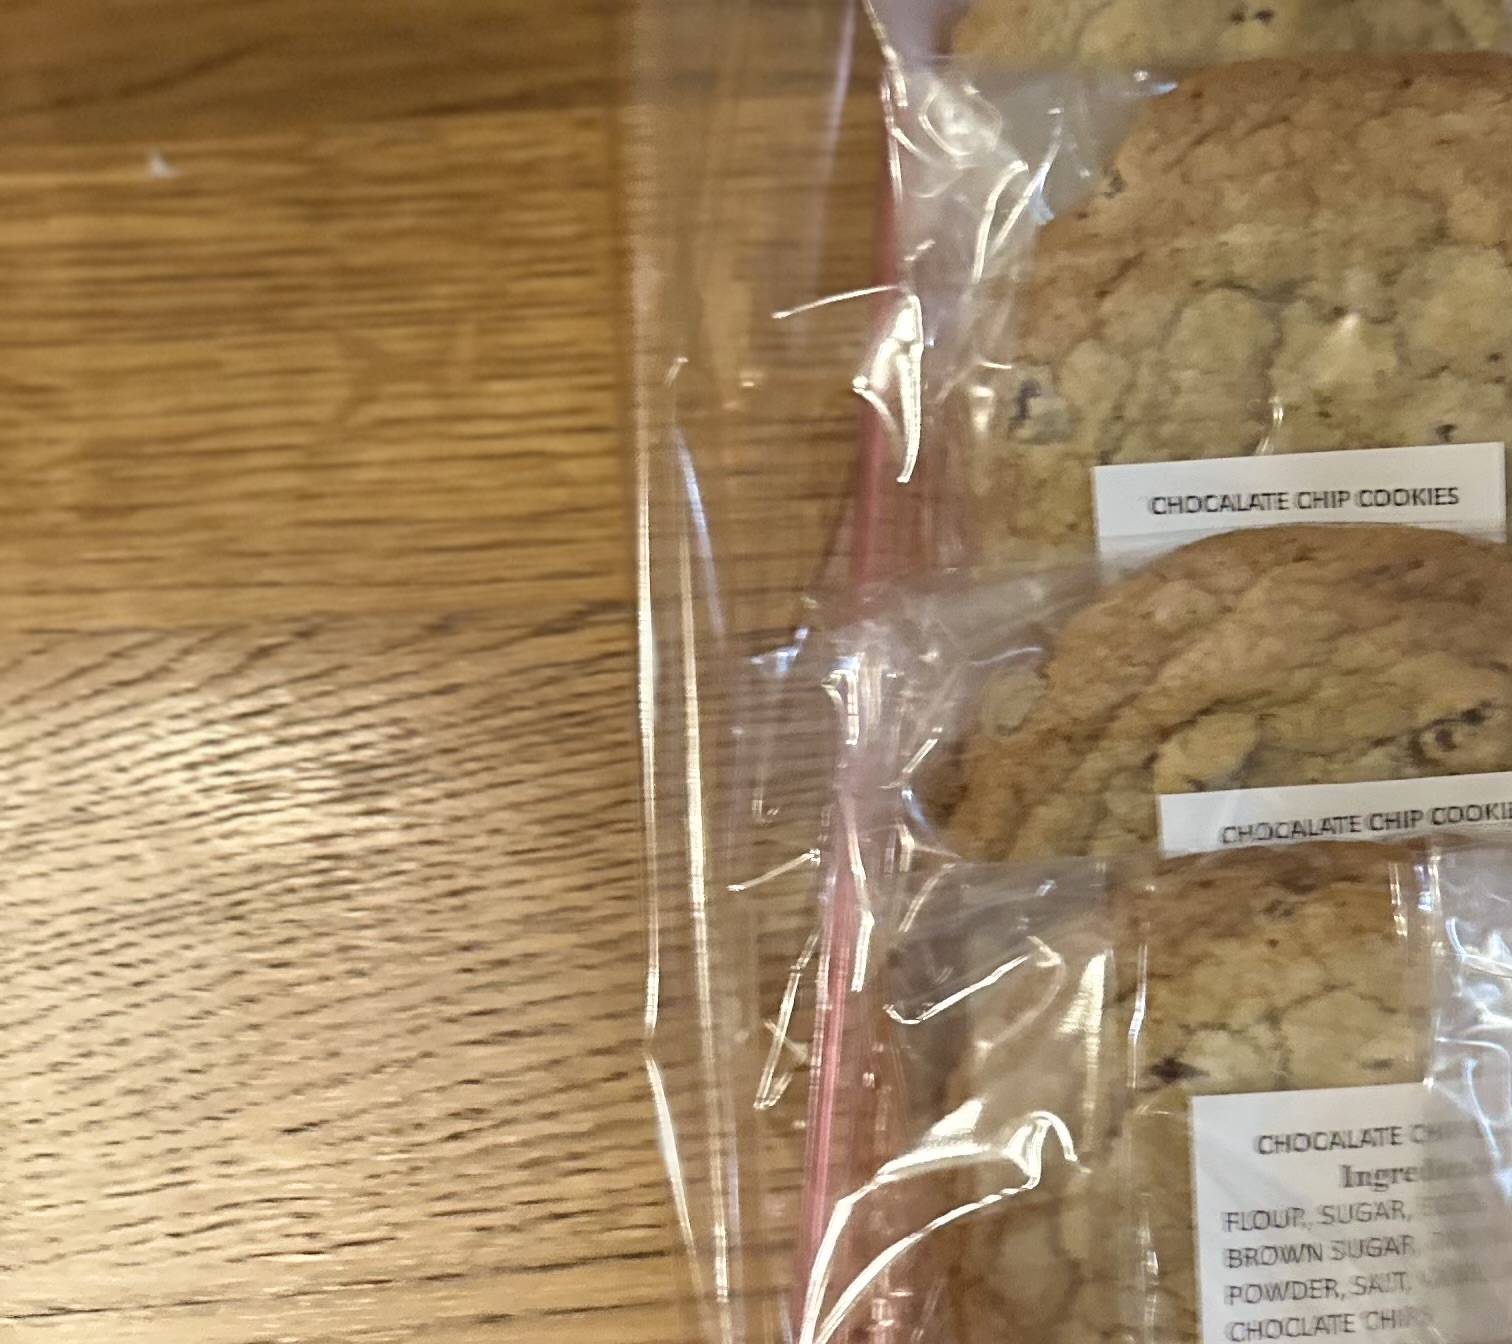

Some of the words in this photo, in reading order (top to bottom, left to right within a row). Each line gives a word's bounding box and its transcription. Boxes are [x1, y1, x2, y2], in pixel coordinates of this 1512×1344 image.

[1149, 492, 1289, 516] CHOCALATE
[1297, 490, 1350, 510] CHIP
[1356, 486, 1459, 508] COOKIES
[1220, 815, 1361, 844] CHOCALATE
[1369, 809, 1424, 831] CHIP
[1256, 1126, 1402, 1155] CHOCALATE
[1318, 1199, 1411, 1226] SUGAR,
[1226, 1242, 1323, 1269] BROWN
[1225, 1278, 1346, 1306] POWDER,
[1229, 1313, 1355, 1344] CHOCLATE
